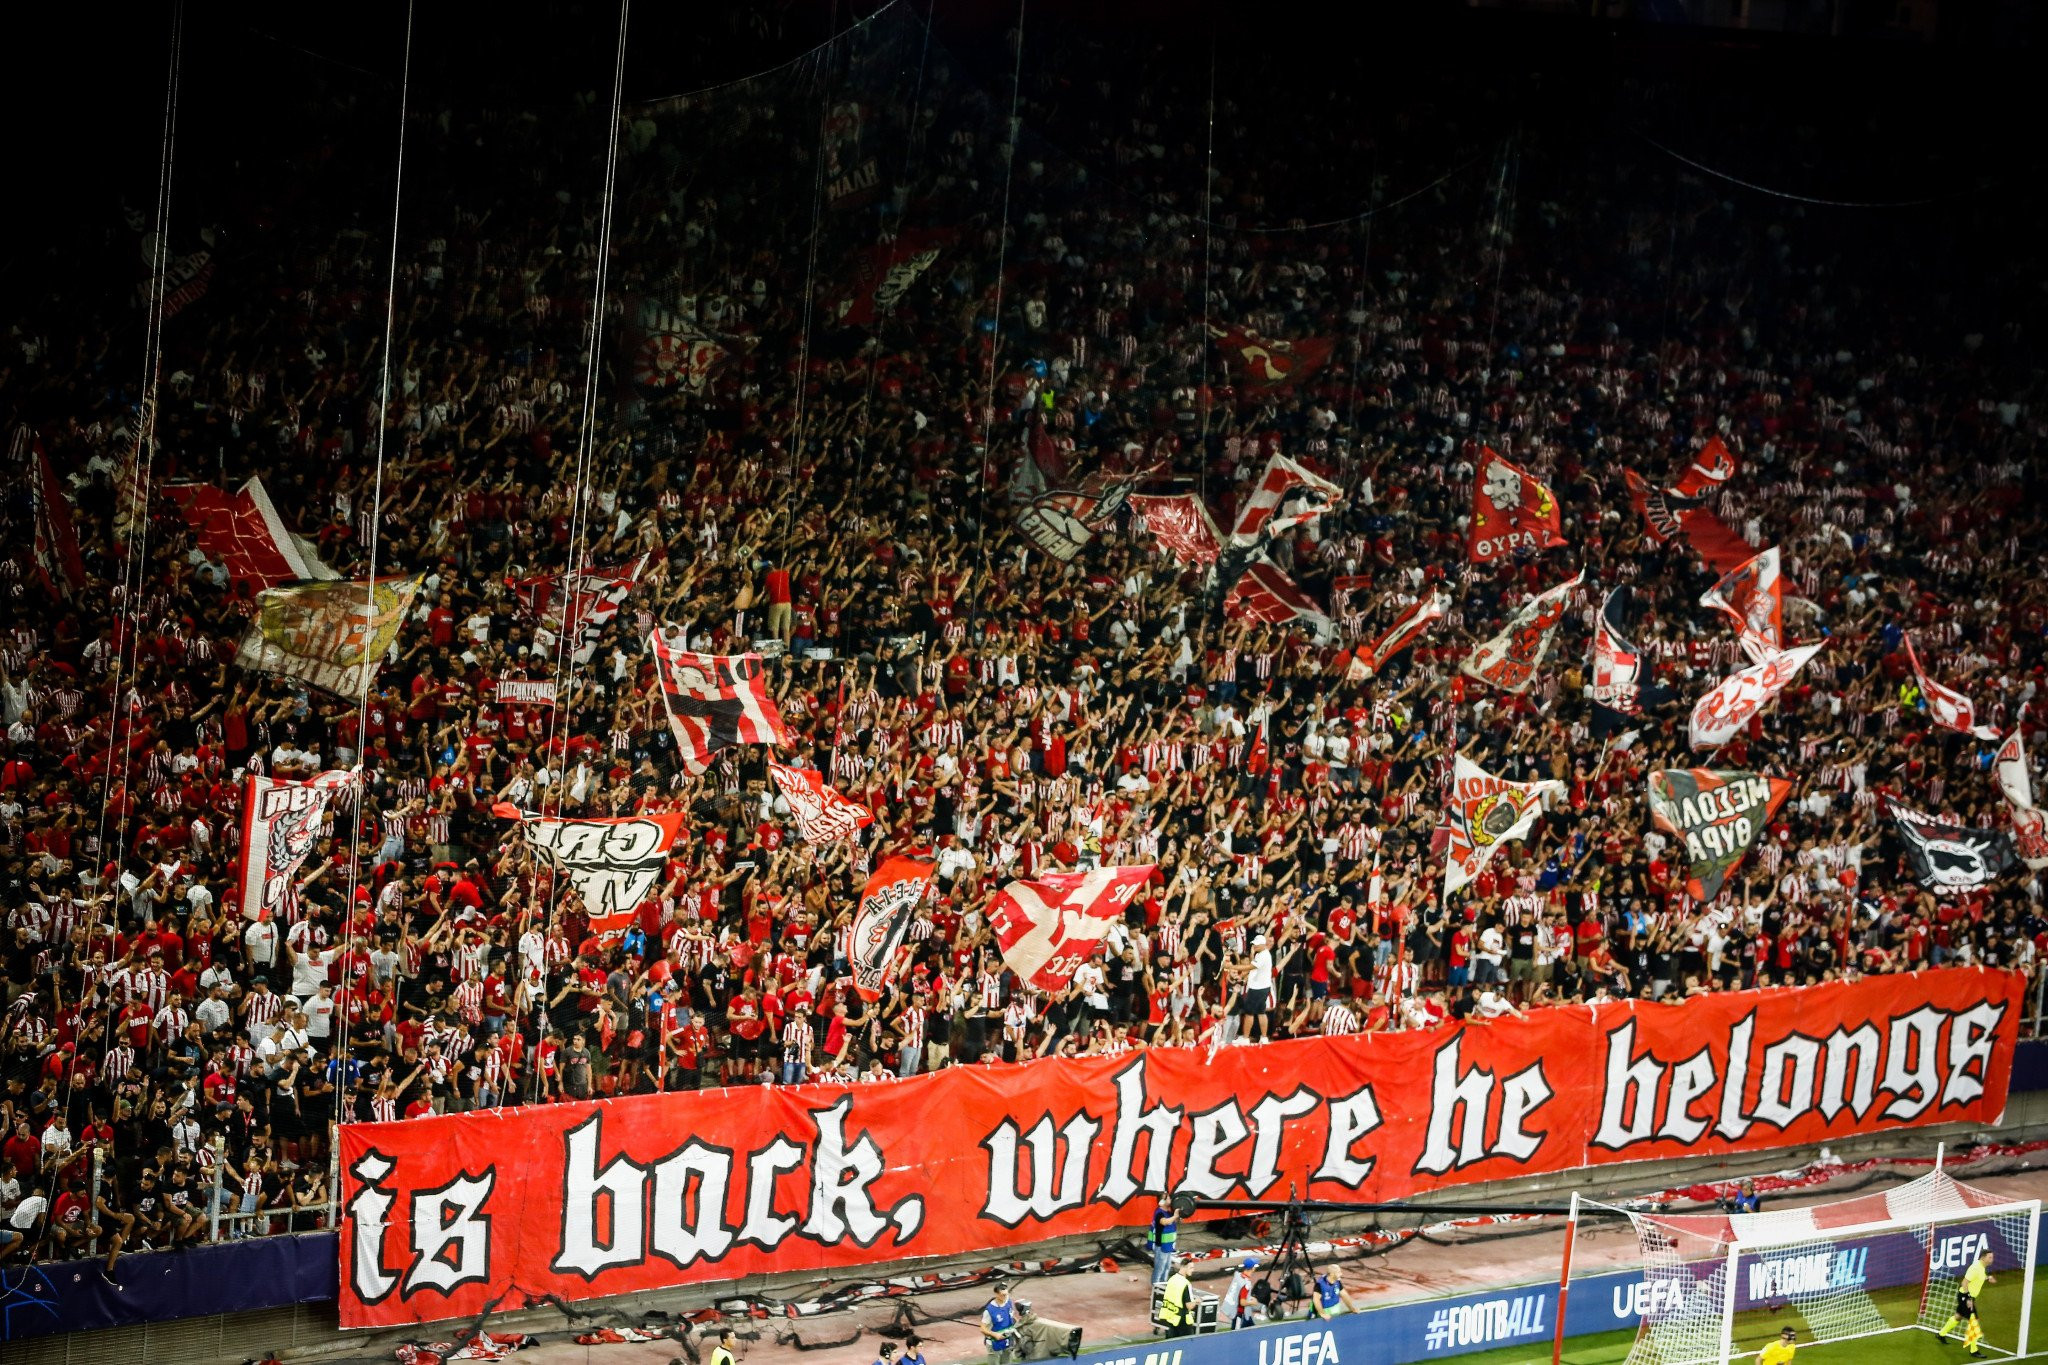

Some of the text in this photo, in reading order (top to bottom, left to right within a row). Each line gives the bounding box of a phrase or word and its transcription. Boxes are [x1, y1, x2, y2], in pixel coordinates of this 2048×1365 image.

[1477, 531, 1536, 556] ΘΥΡΑ
[346, 997, 2010, 1306] is back, where he belongs
[1613, 1278, 1684, 1318] UEFA
[1259, 1331, 1339, 1365] UEFA
